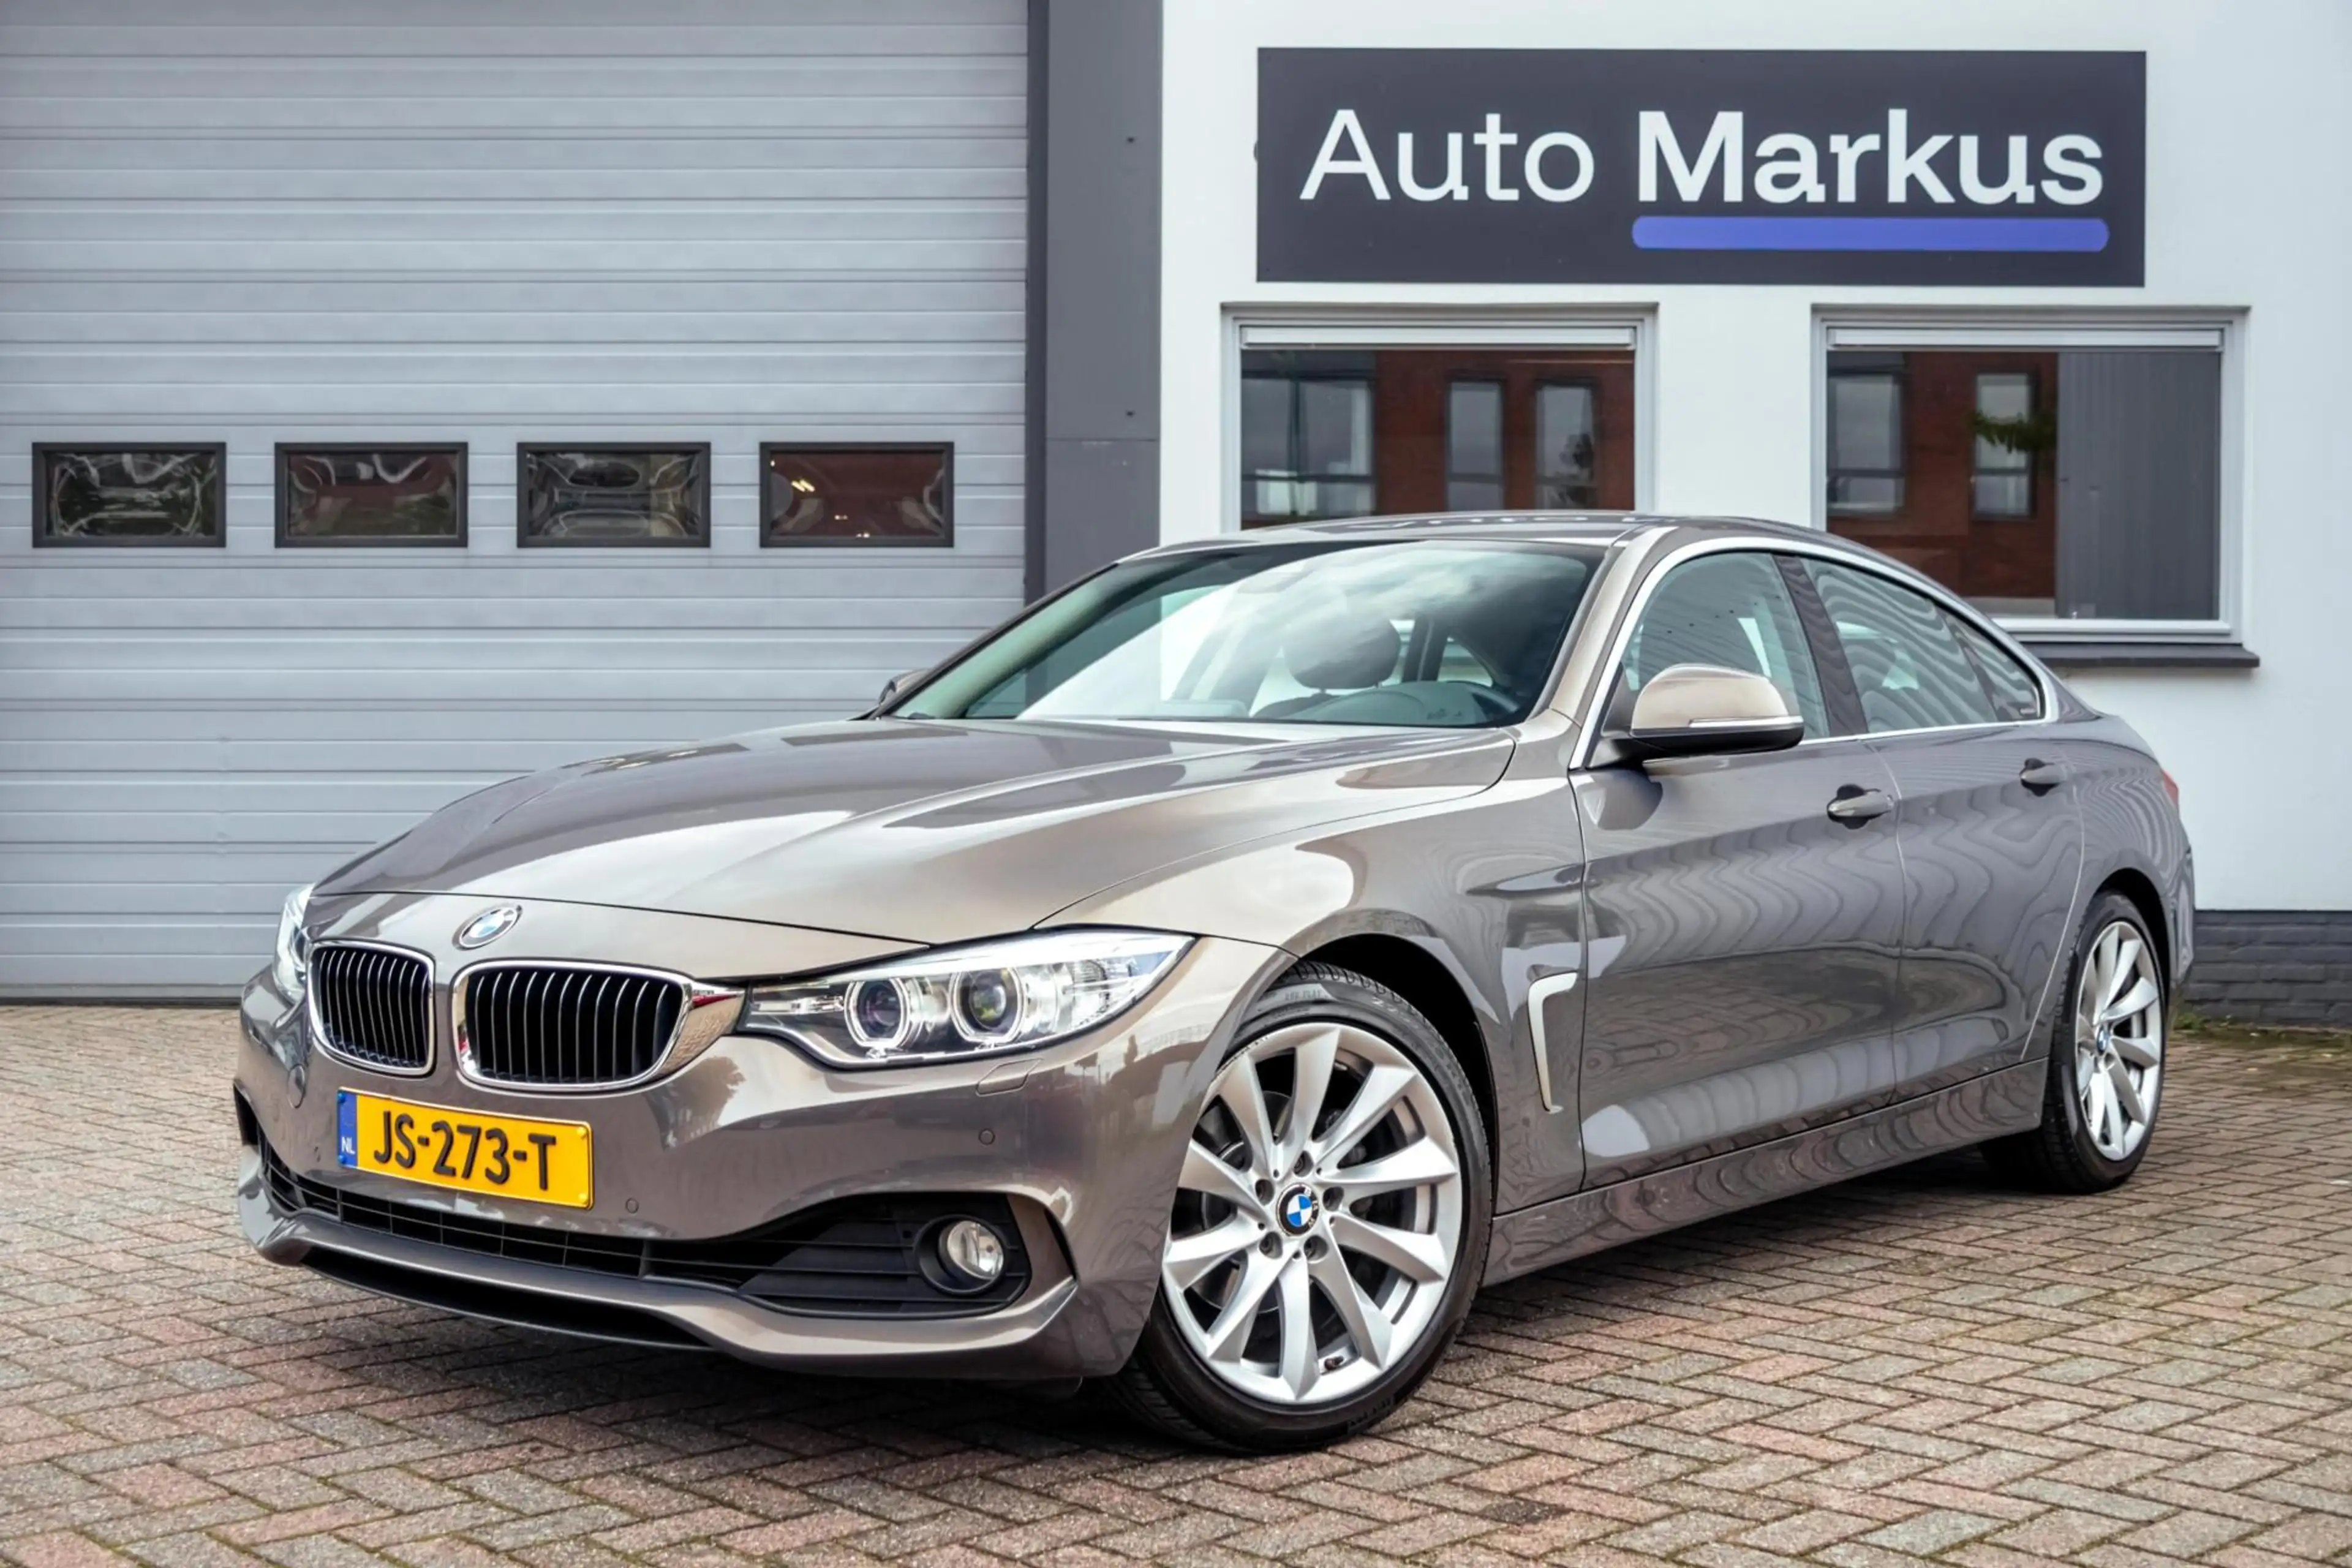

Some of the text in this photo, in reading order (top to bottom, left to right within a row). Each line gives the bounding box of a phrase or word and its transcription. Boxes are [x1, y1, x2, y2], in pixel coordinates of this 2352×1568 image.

[1299, 108, 2103, 205] Auto Markus
[341, 1136, 356, 1155] NL
[374, 1110, 557, 1191] JS-273-T
